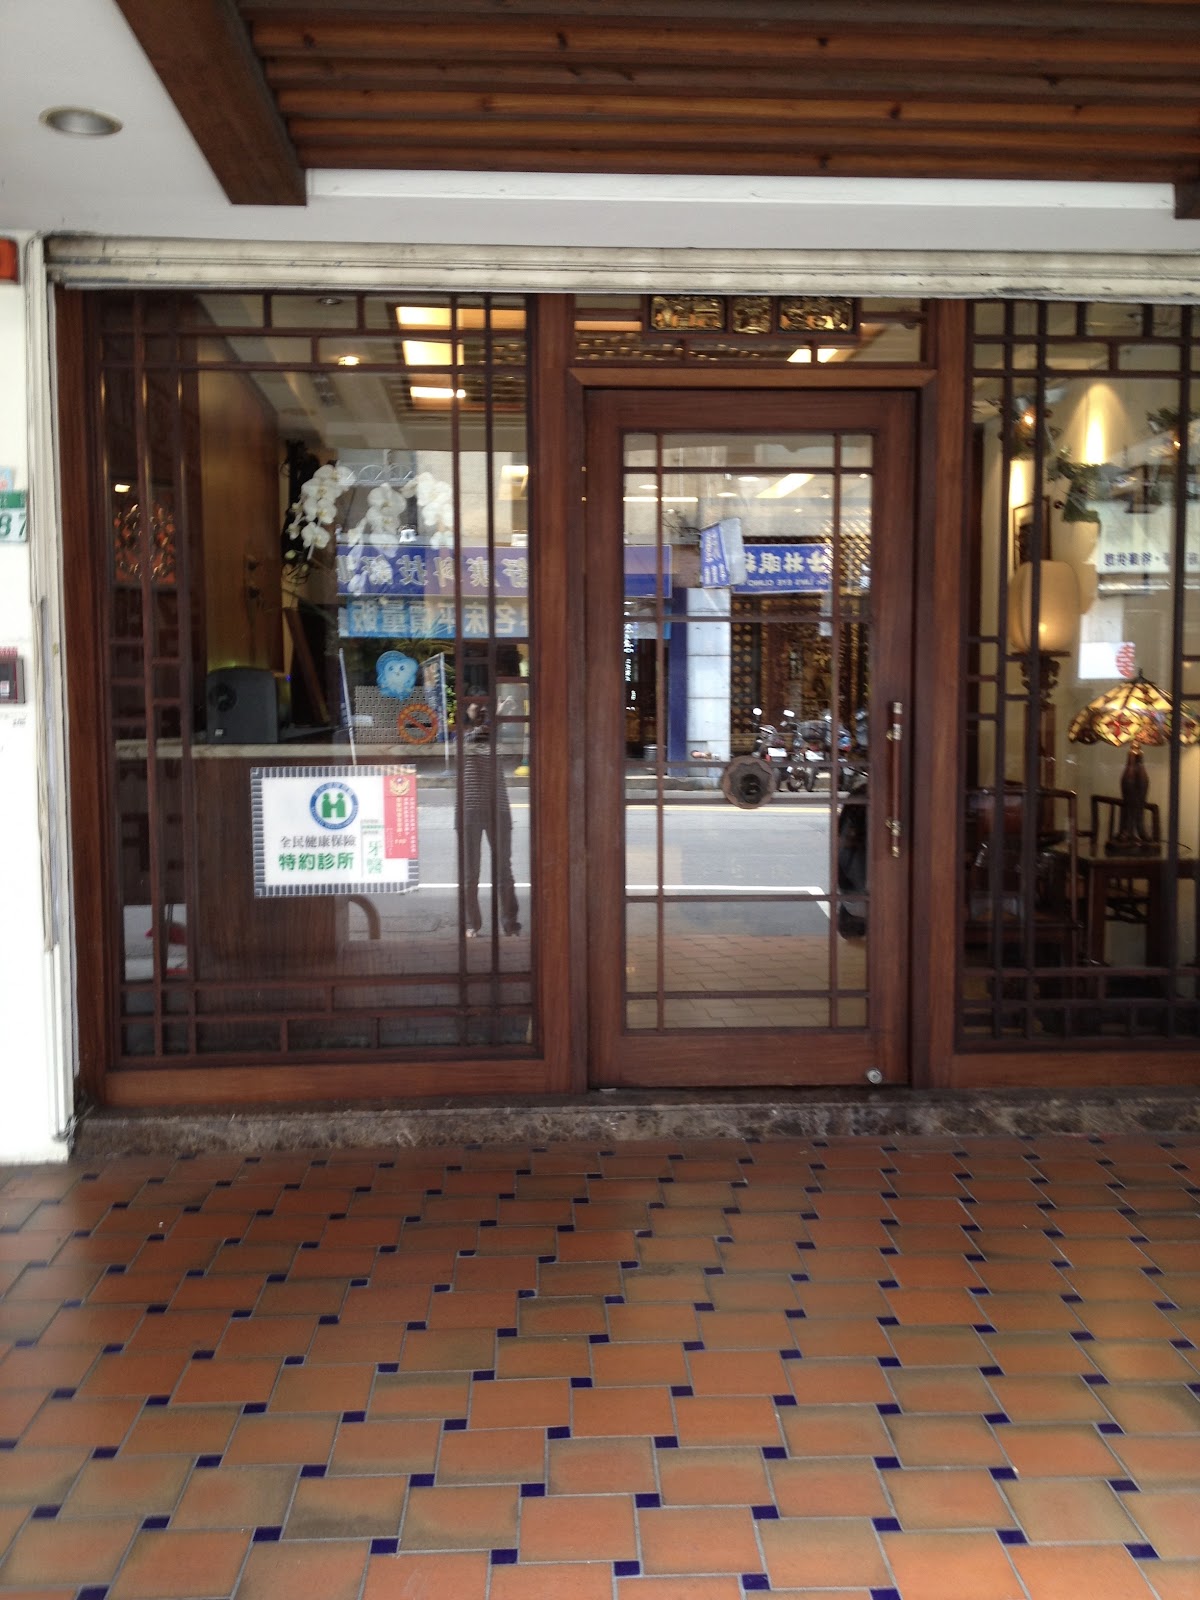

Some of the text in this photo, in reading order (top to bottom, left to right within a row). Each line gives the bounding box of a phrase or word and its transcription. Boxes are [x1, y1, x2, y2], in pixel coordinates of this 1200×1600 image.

[280, 834, 357, 849] 全民健康保險
[278, 851, 354, 871] 特約診所
